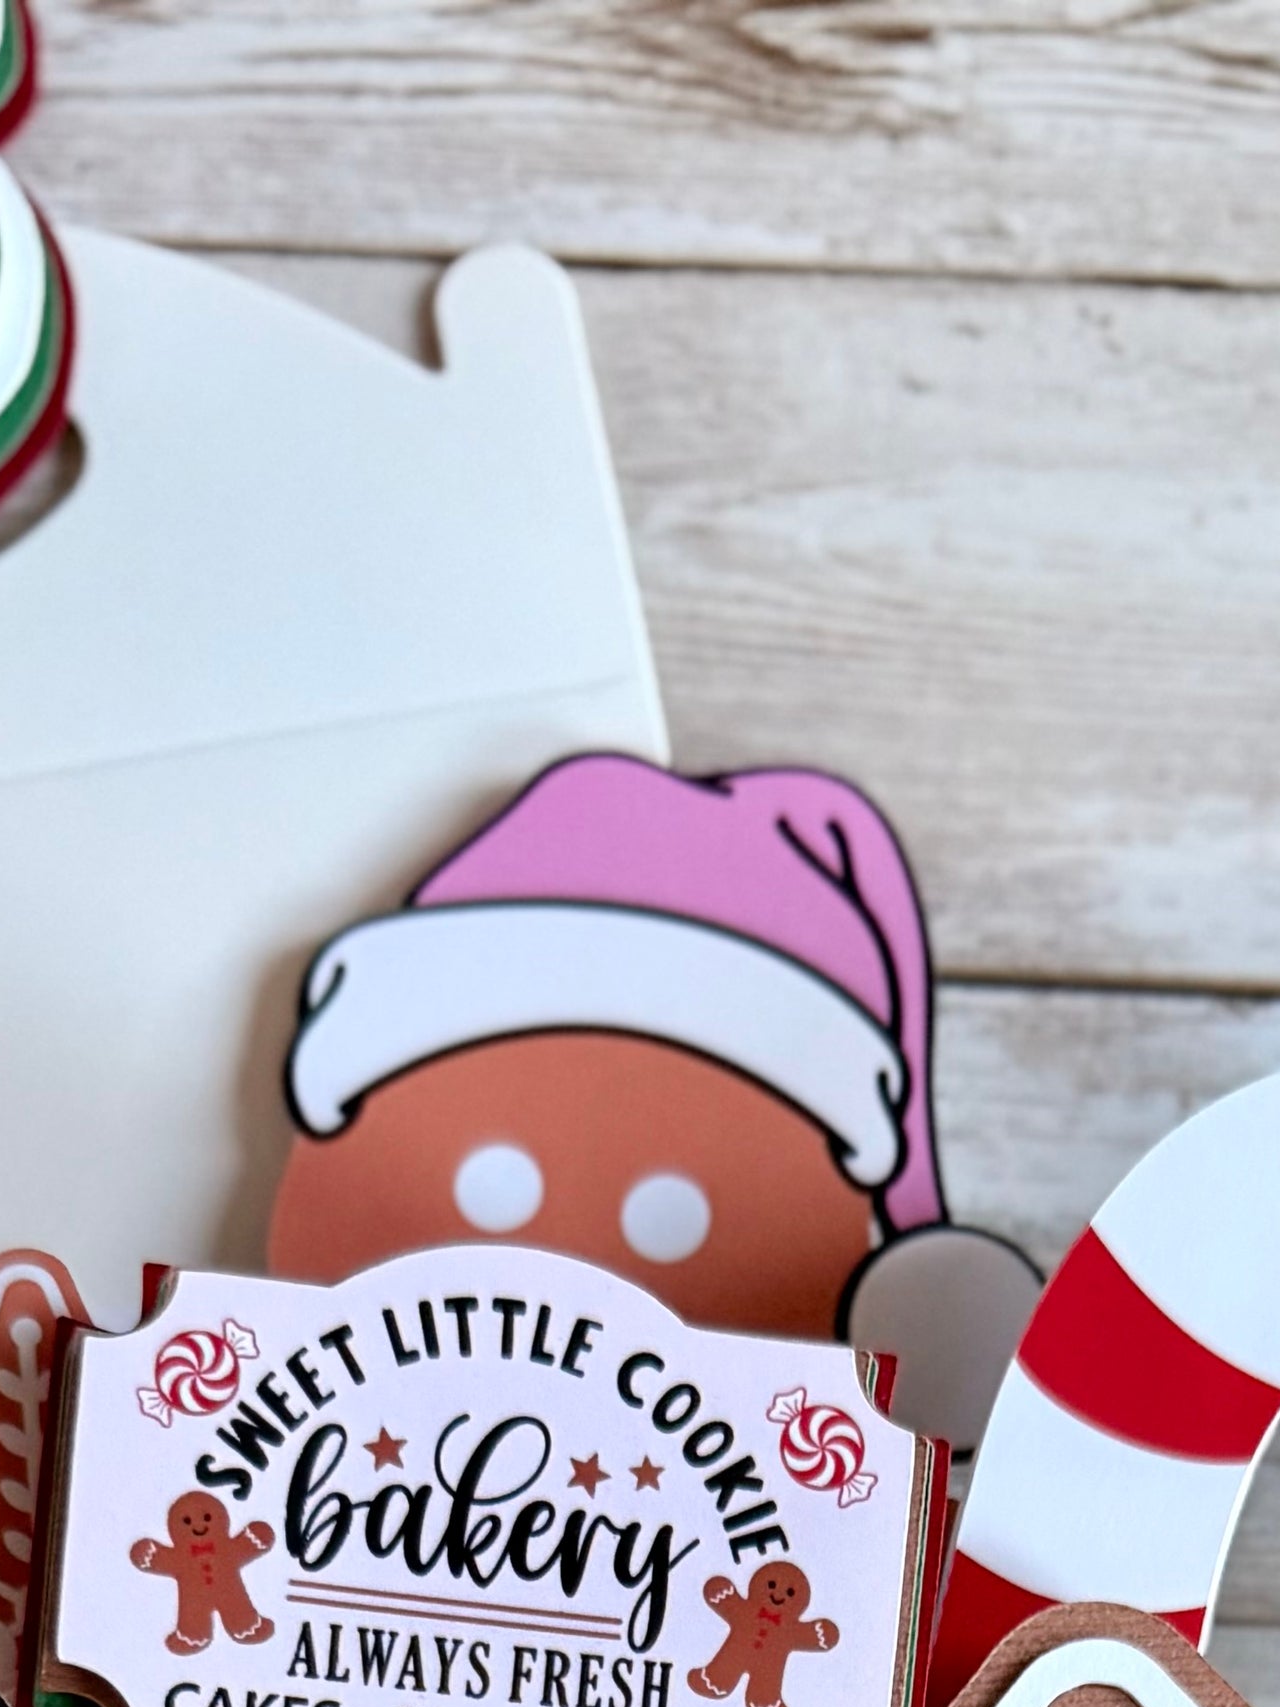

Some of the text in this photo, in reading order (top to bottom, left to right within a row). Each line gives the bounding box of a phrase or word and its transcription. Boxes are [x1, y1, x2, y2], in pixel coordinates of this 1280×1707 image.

[196, 1295, 789, 1565] SWEET LITTLE COOKIE
[284, 1414, 701, 1652] bakery
[287, 1621, 491, 1699] ALWAYS
